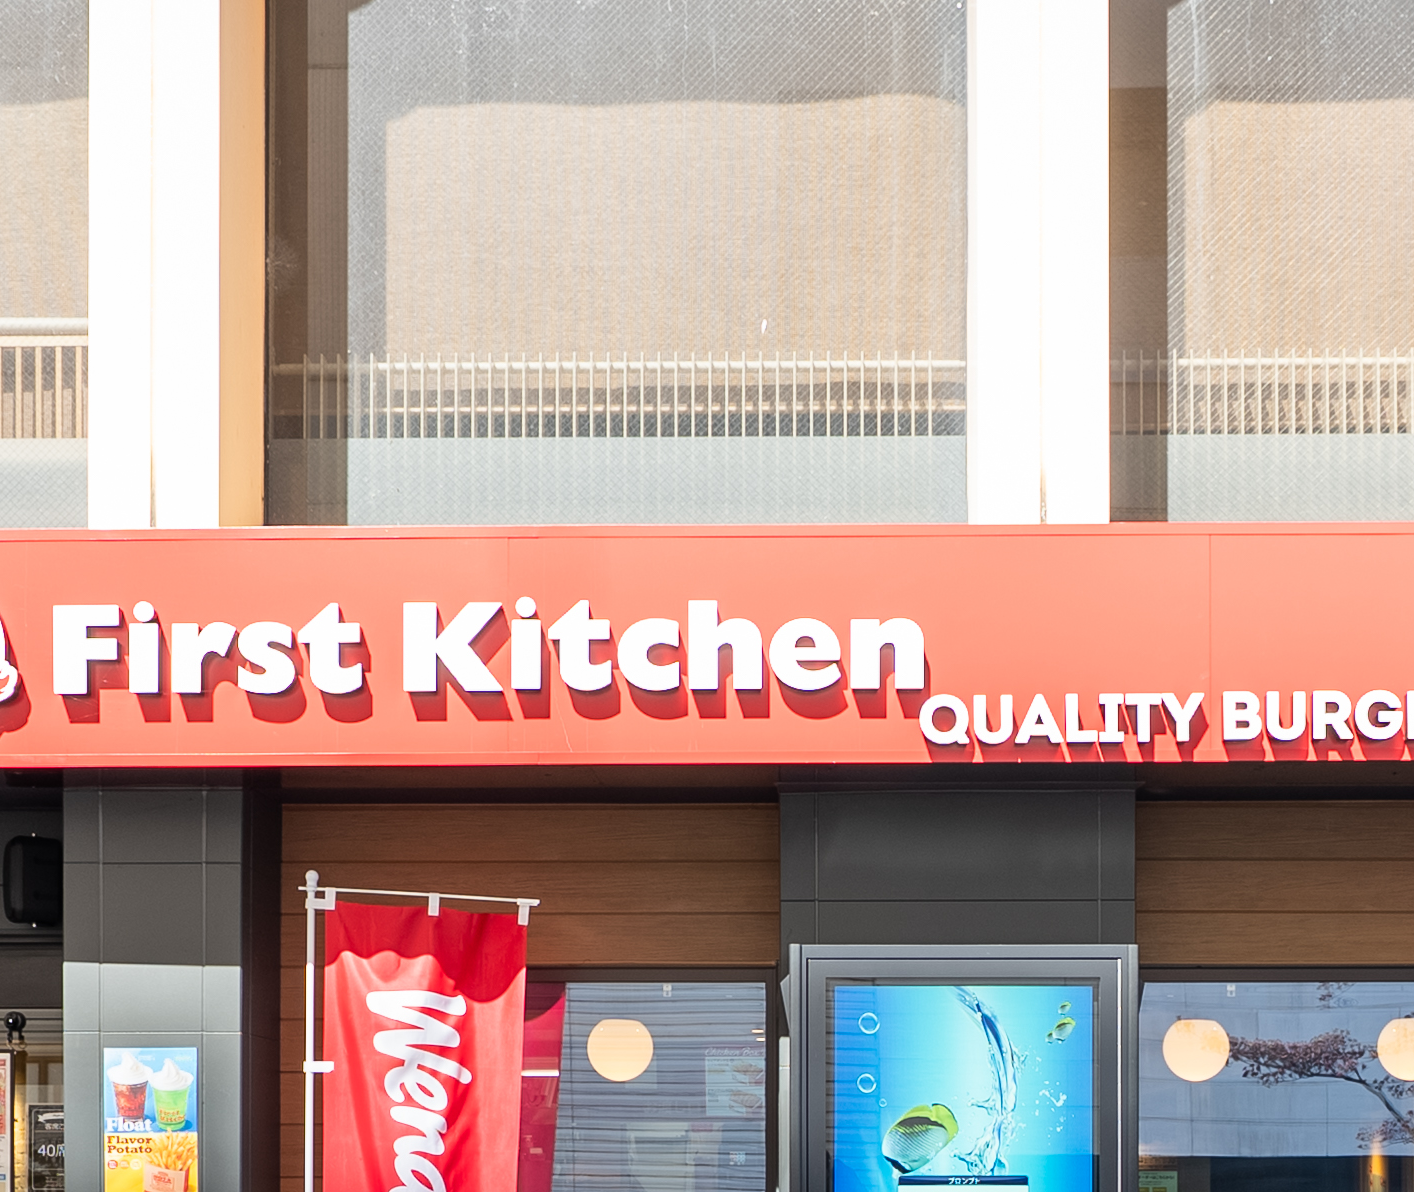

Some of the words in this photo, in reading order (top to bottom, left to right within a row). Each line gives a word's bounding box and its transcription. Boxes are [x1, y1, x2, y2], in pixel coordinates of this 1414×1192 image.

[52, 600, 363, 696] First
[402, 596, 926, 693] Kitchen
[917, 691, 1206, 745] QUALITY
[106, 1116, 153, 1132] Float
[107, 1136, 153, 1145] Flavor
[107, 1145, 153, 1155] Potato
